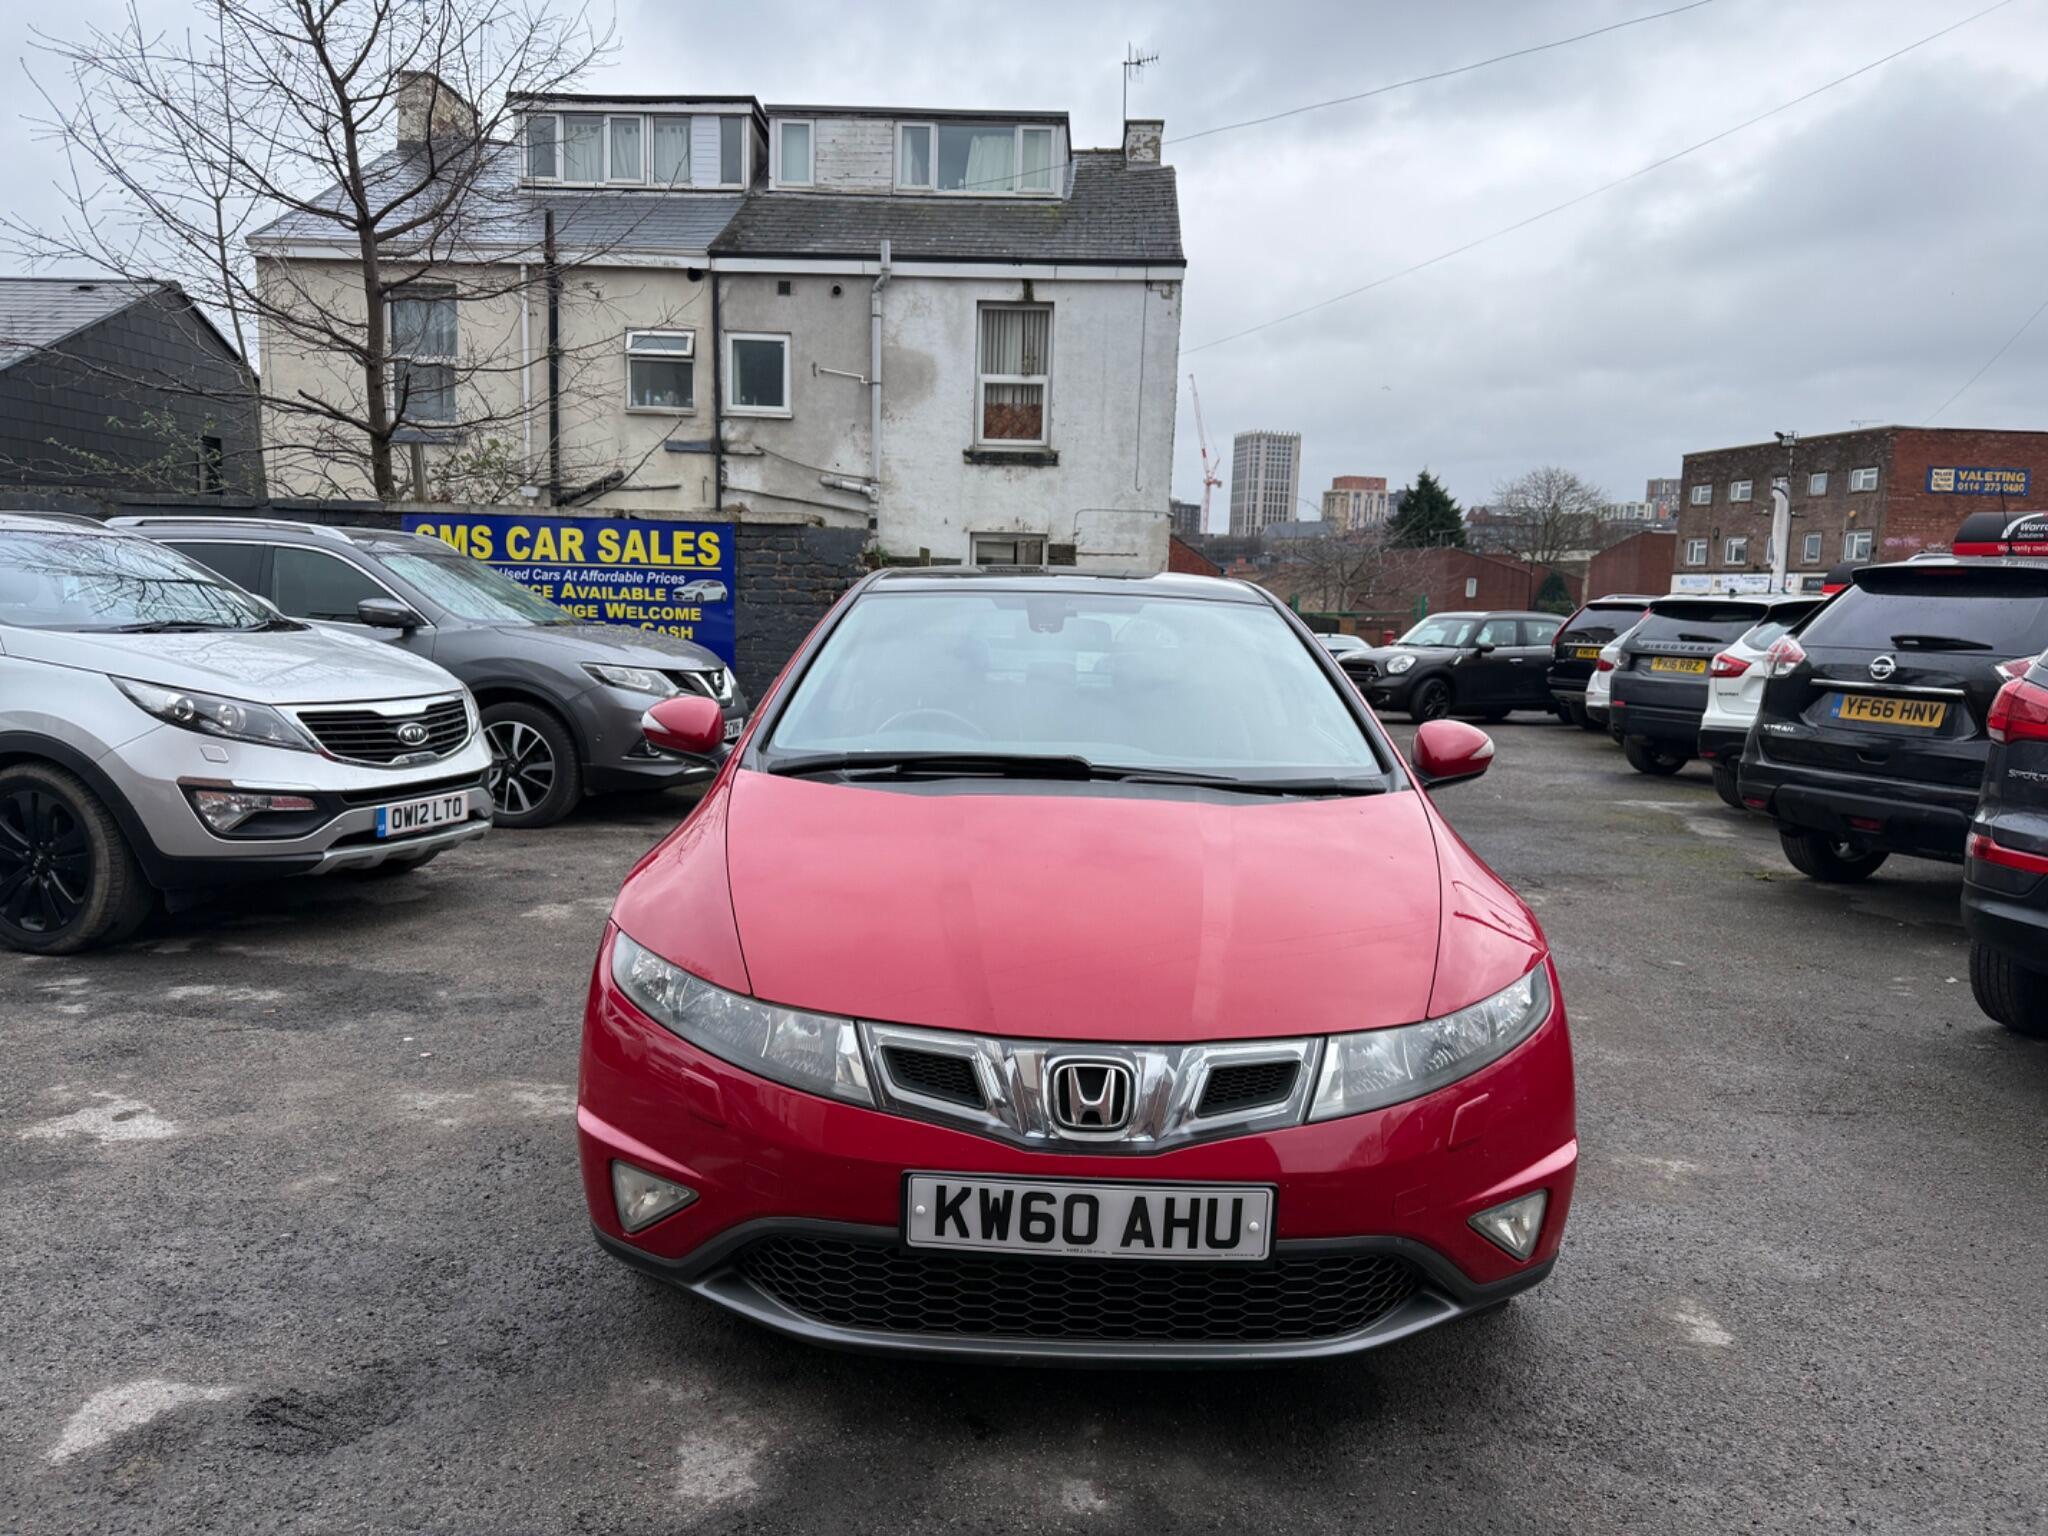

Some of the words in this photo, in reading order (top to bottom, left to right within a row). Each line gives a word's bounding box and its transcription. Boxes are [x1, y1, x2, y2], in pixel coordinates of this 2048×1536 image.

[1957, 482, 1980, 491] 0114
[1959, 471, 2026, 483] VALETING
[506, 525, 585, 563] CAR
[597, 527, 721, 566] SALES
[532, 568, 560, 581] Cars
[563, 569, 578, 582] At
[579, 570, 644, 584] Affordable
[647, 572, 685, 585] Prices
[561, 582, 667, 601] AVAILABLE
[605, 602, 702, 622] WELCOME
[1846, 696, 1896, 718] YF66
[1899, 701, 1941, 723] HNV
[392, 803, 430, 829] OW12
[433, 797, 462, 822] LTO
[933, 1183, 1099, 1245] KW60
[1119, 1194, 1243, 1250] AHU
